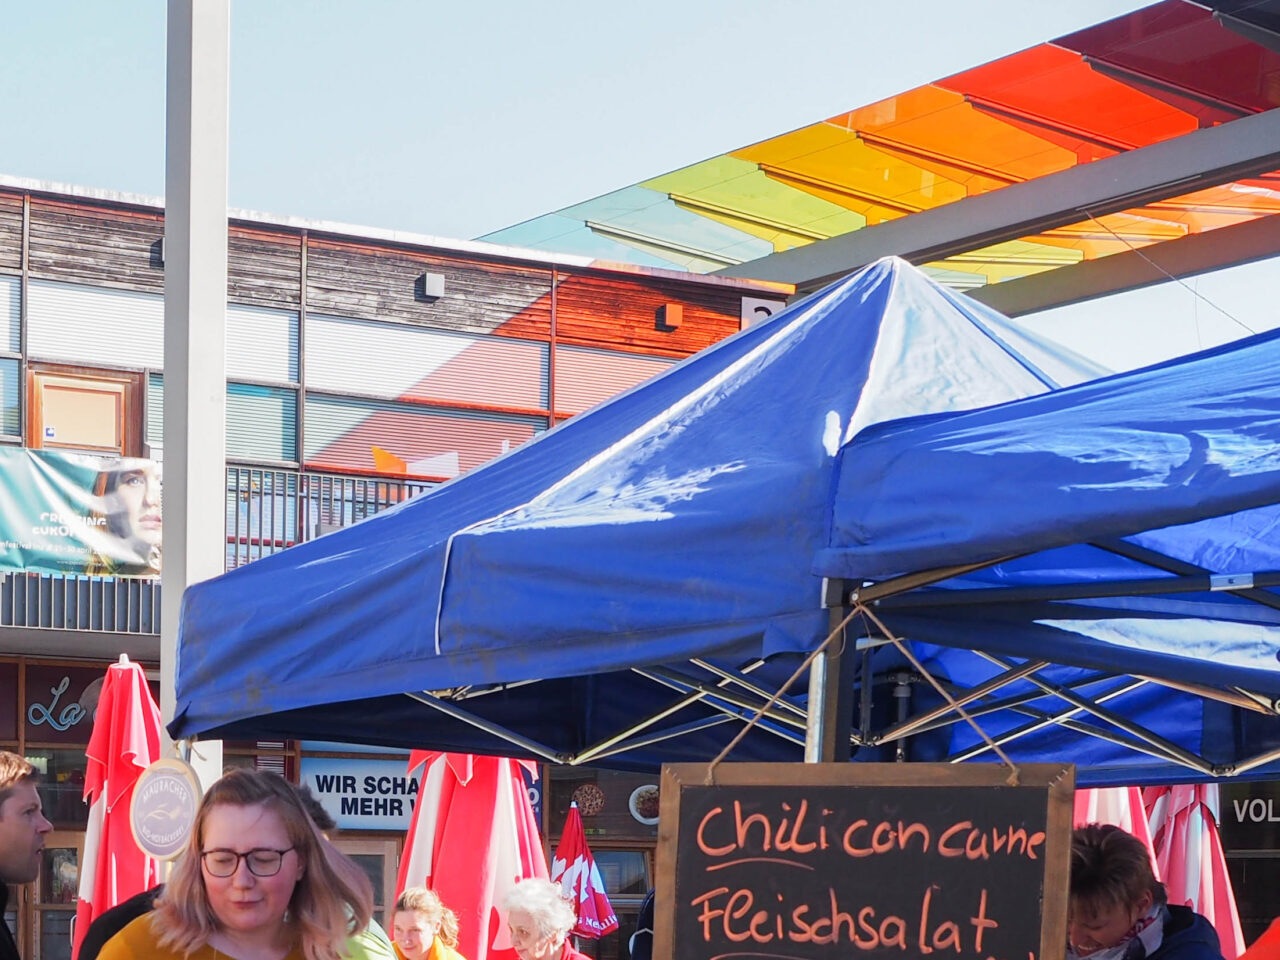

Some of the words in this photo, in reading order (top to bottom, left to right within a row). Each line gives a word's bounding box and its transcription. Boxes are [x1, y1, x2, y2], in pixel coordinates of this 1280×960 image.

[40, 511, 107, 527] CROING
[315, 774, 357, 794] WIR
[363, 776, 420, 796] SCHA
[341, 797, 404, 817] MEHR
[1233, 798, 1280, 823] VOL
[842, 818, 931, 858] con
[690, 885, 999, 956] Fleischsalat
